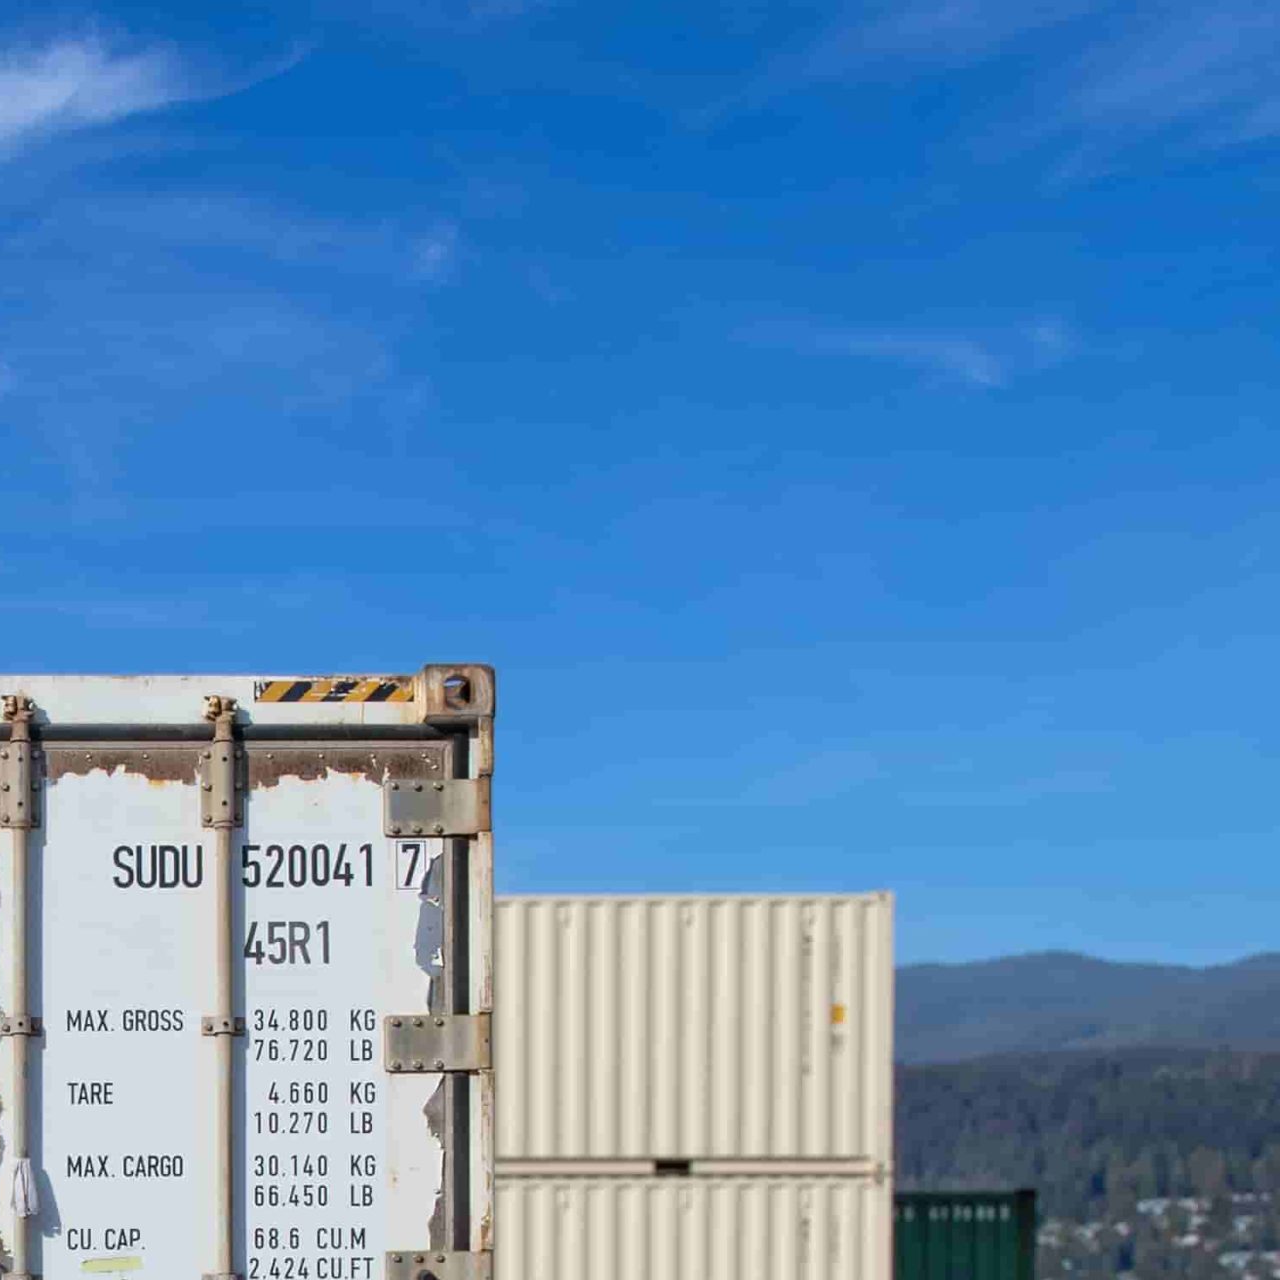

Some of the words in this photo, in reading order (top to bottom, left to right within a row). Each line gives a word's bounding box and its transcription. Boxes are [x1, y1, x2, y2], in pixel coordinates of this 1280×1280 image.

[113, 844, 203, 889] SUDU
[241, 843, 374, 888] 520041
[401, 844, 421, 887] 7
[243, 920, 330, 965] 45R1
[66, 1009, 114, 1032] MAX.
[122, 1009, 184, 1032] GROSS
[253, 1009, 328, 1032] 34.800
[350, 1009, 376, 1032] KG
[253, 1039, 328, 1062] 76.720
[350, 1039, 373, 1062] LB
[67, 1082, 114, 1105] TARE
[267, 1081, 328, 1104] 4.660
[350, 1081, 376, 1104] KG
[253, 1111, 328, 1134] 10.270
[350, 1111, 373, 1134] LB
[67, 1155, 115, 1178] MAX.
[123, 1155, 184, 1178] CARGO
[253, 1154, 328, 1177] 30.140
[350, 1154, 376, 1177] KG
[253, 1185, 328, 1207] 66.450
[350, 1184, 373, 1207] LB
[67, 1228, 97, 1251] CU.
[104, 1228, 146, 1251] CAP.
[253, 1227, 300, 1250] 68.6
[316, 1227, 366, 1250] CU.M
[249, 1257, 309, 1280] 2.424
[316, 1257, 374, 1280] CU.FT
